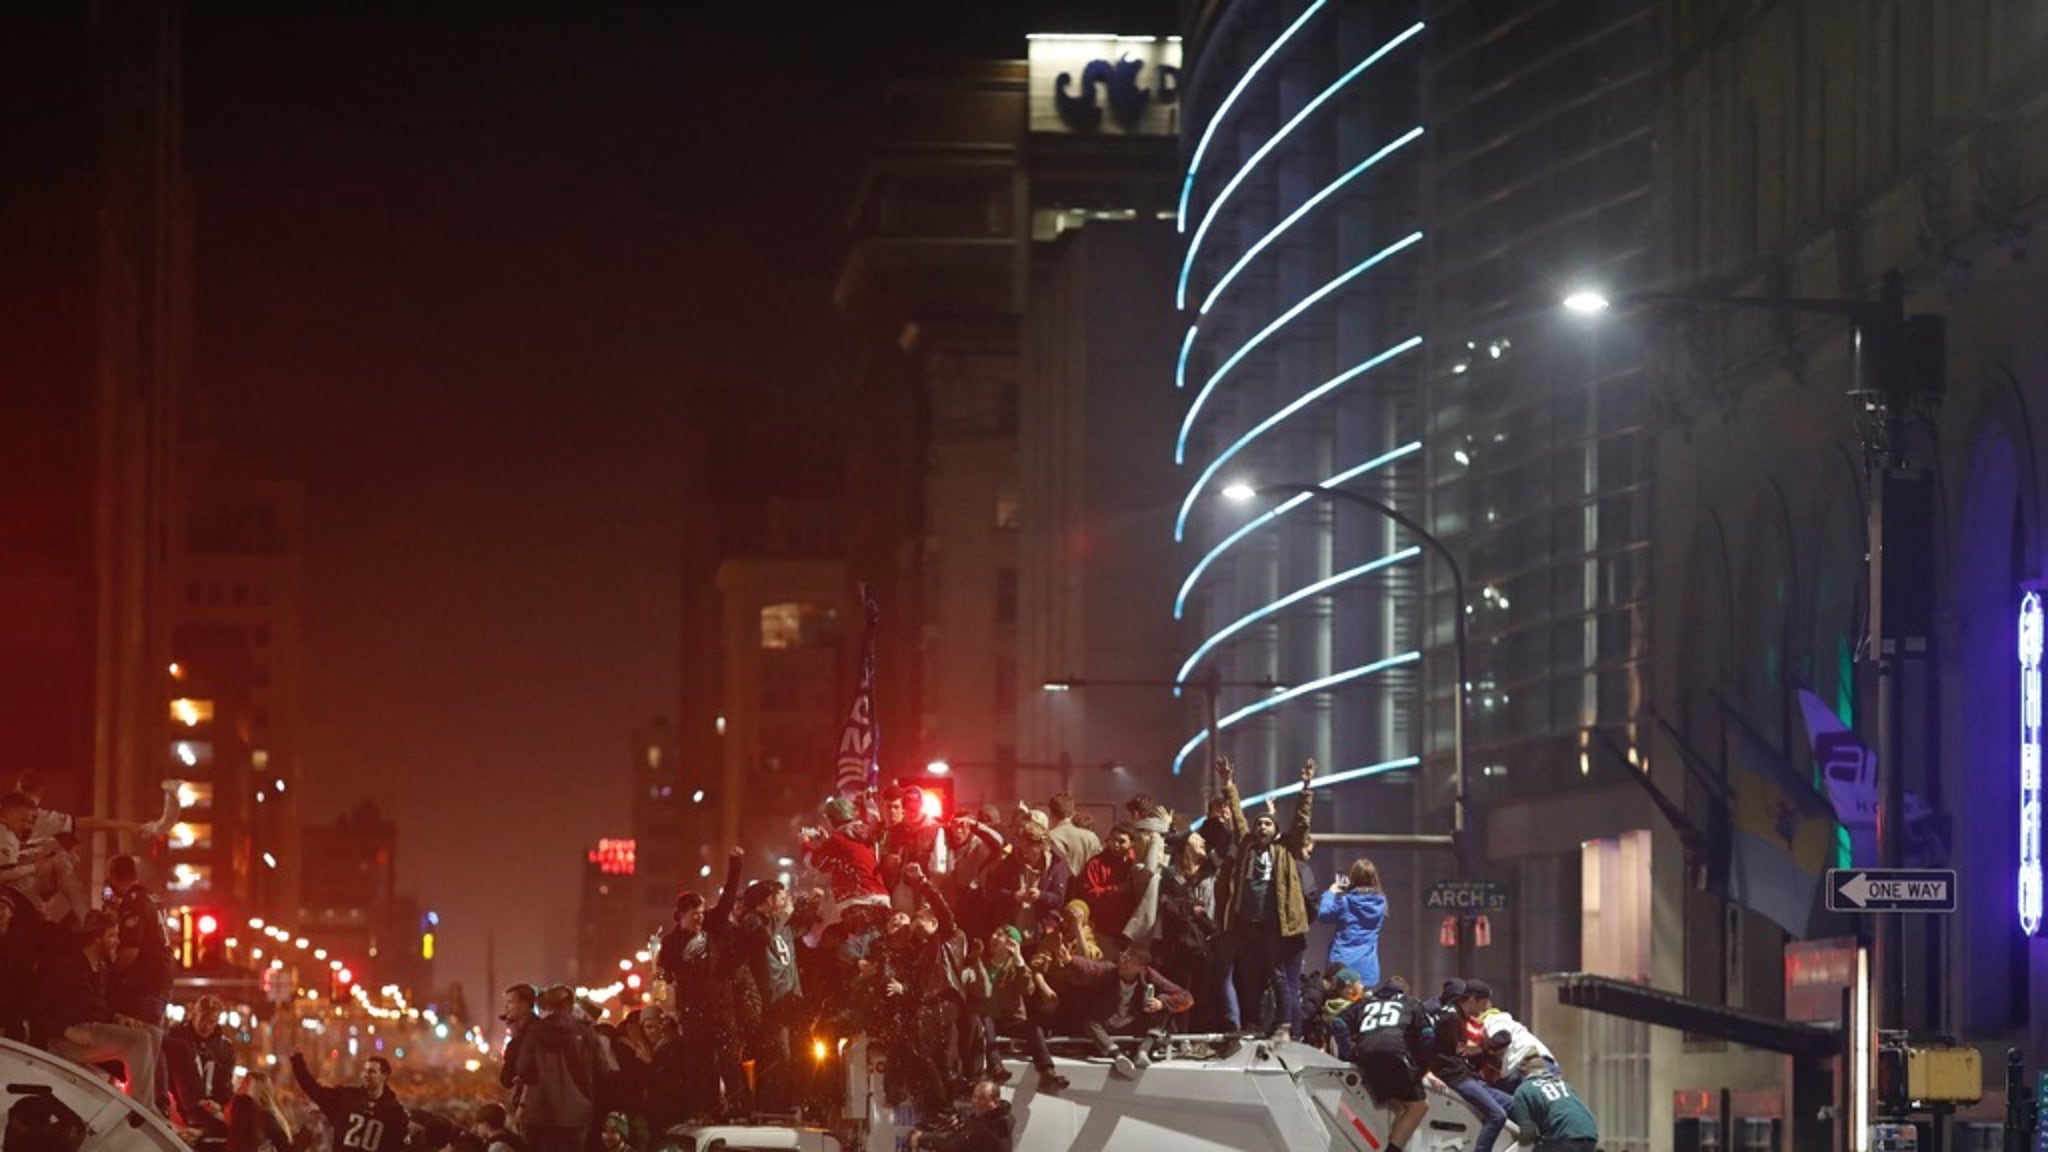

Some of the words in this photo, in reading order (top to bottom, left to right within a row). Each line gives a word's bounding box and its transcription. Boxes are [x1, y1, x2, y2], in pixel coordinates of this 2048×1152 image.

[1427, 889, 1485, 907] ARCH
[1489, 895, 1506, 907] ST
[1869, 882, 1902, 898] ONE
[1907, 882, 1942, 898] WAY
[1359, 1001, 1404, 1032] 25
[1540, 1079, 1570, 1101] 87
[342, 1112, 385, 1151] 20
